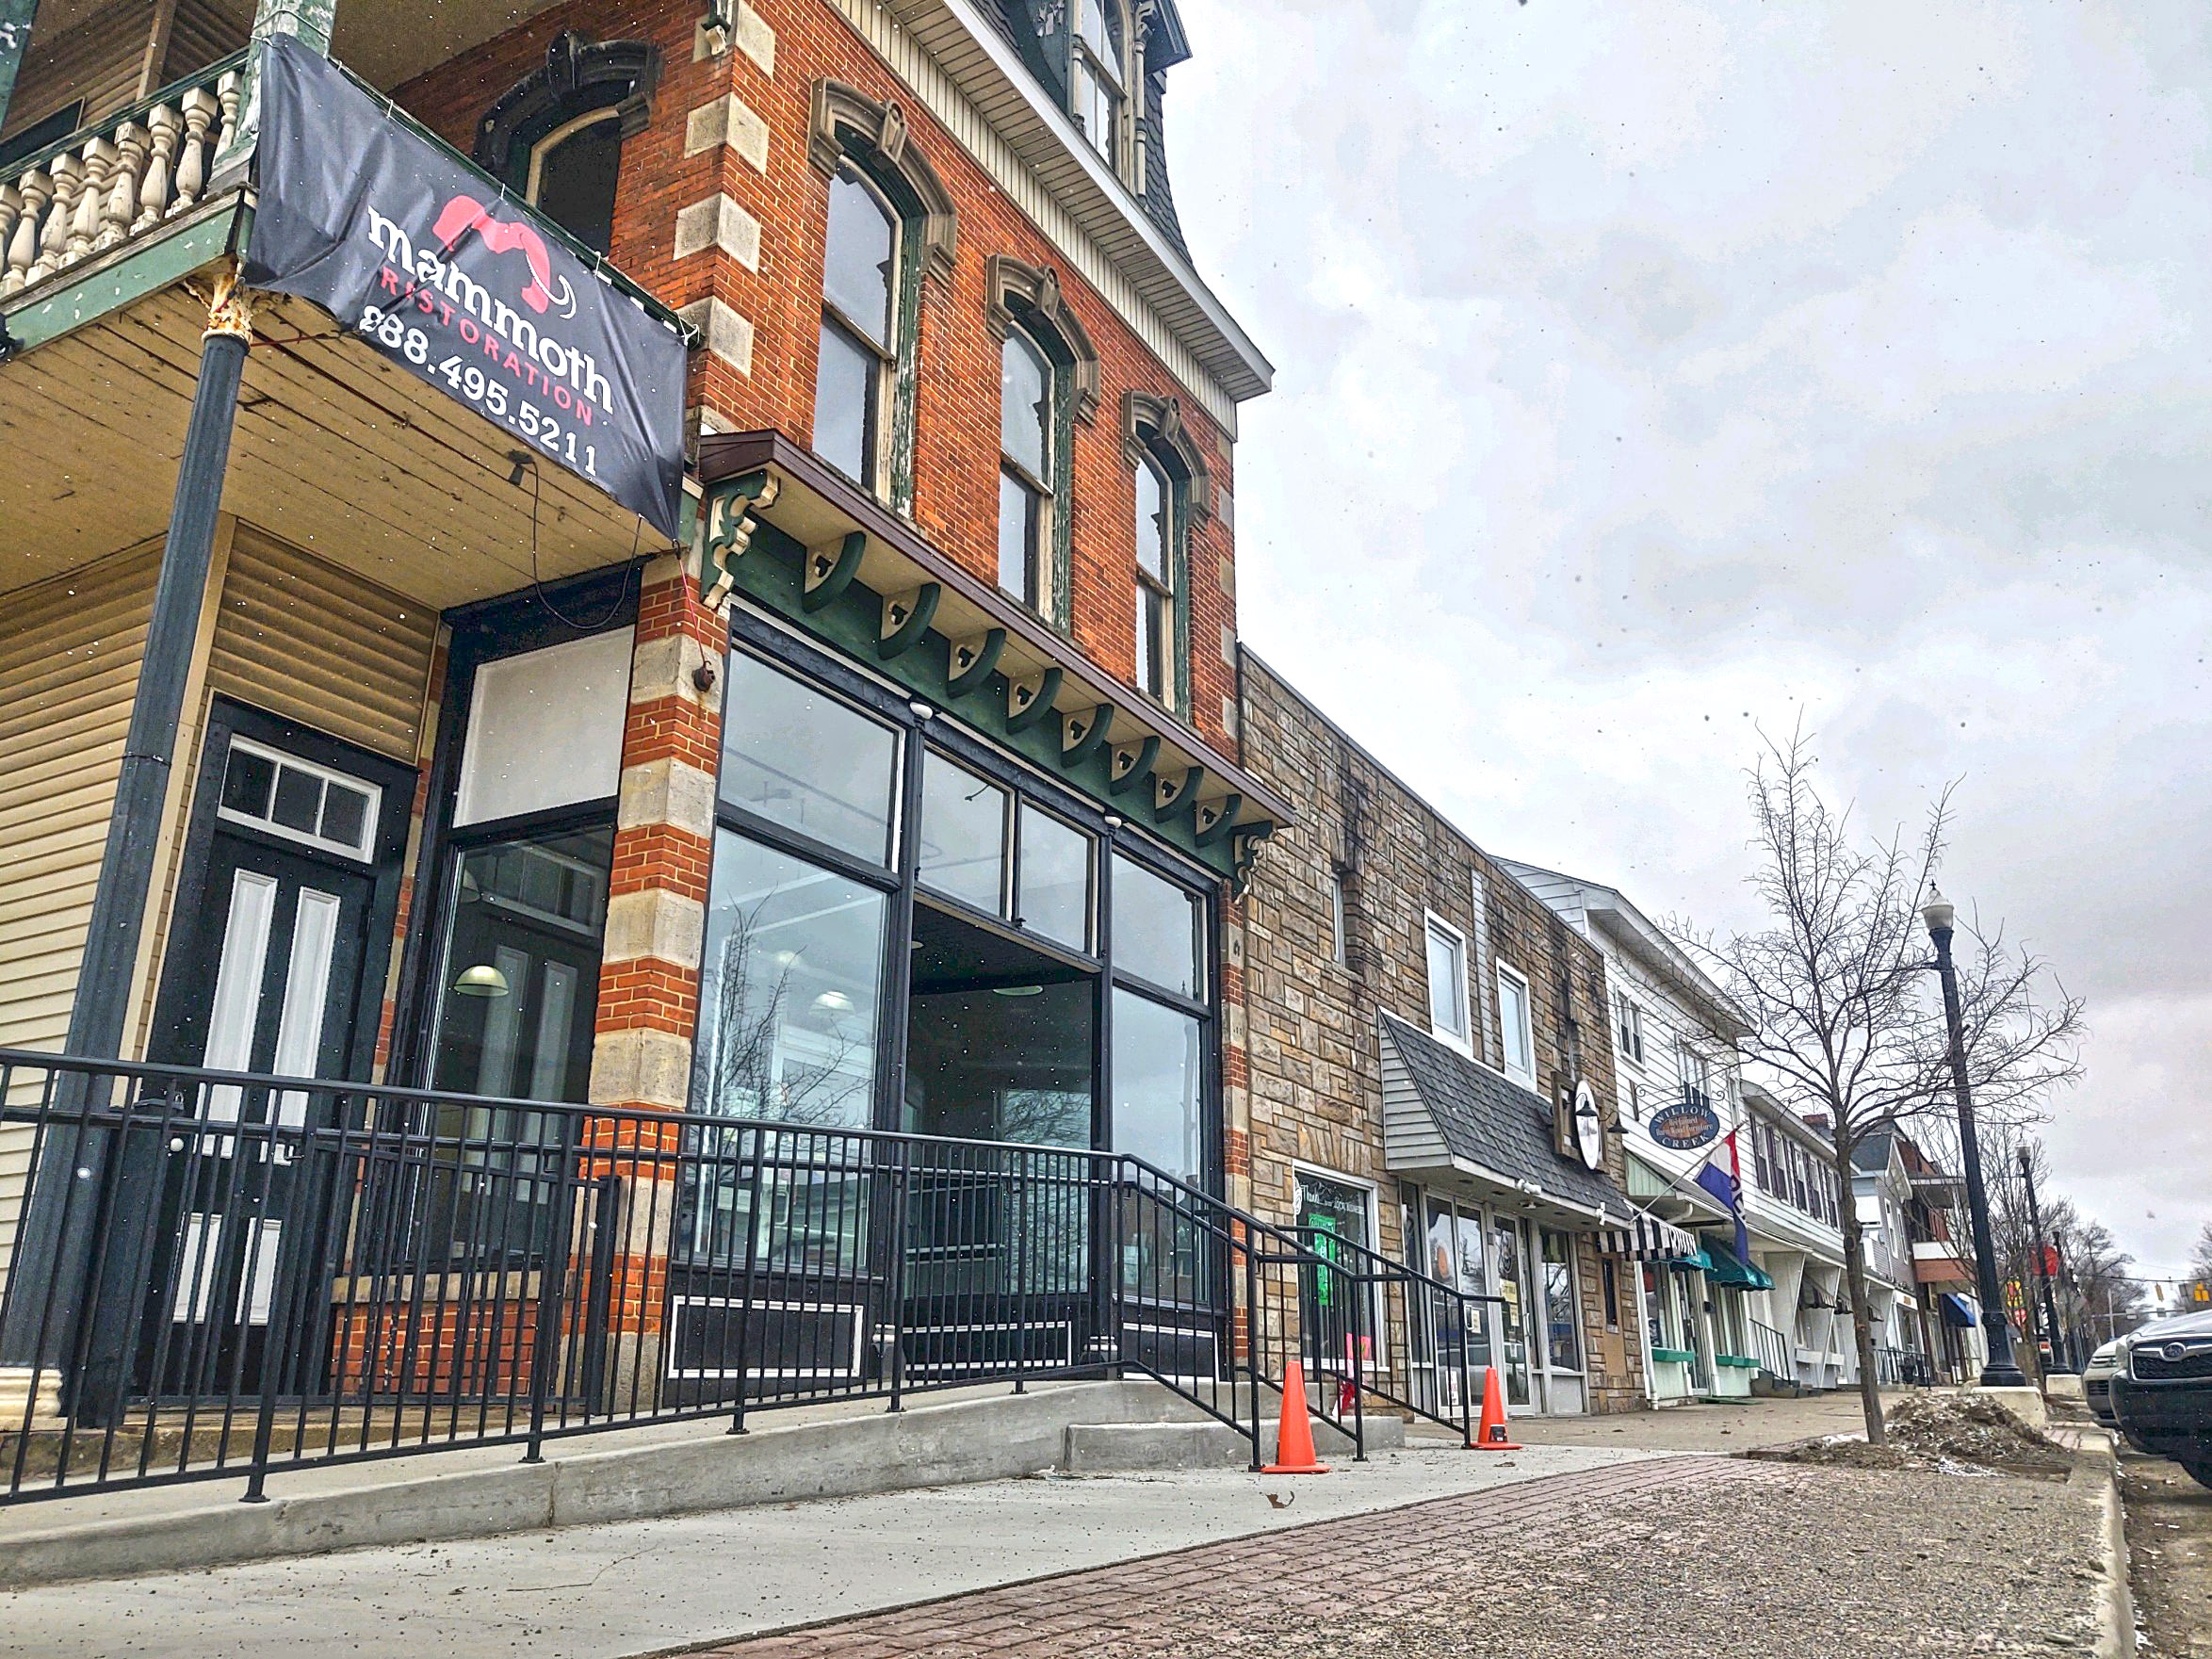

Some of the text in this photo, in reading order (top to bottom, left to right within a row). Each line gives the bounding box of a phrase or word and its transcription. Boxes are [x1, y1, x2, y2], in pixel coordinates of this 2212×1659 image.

[368, 205, 613, 415] mammoth
[359, 305, 596, 476] 888.495.5211
[1654, 1106, 1711, 1124] WILLOW
[1662, 1132, 1710, 1148] CREEK
